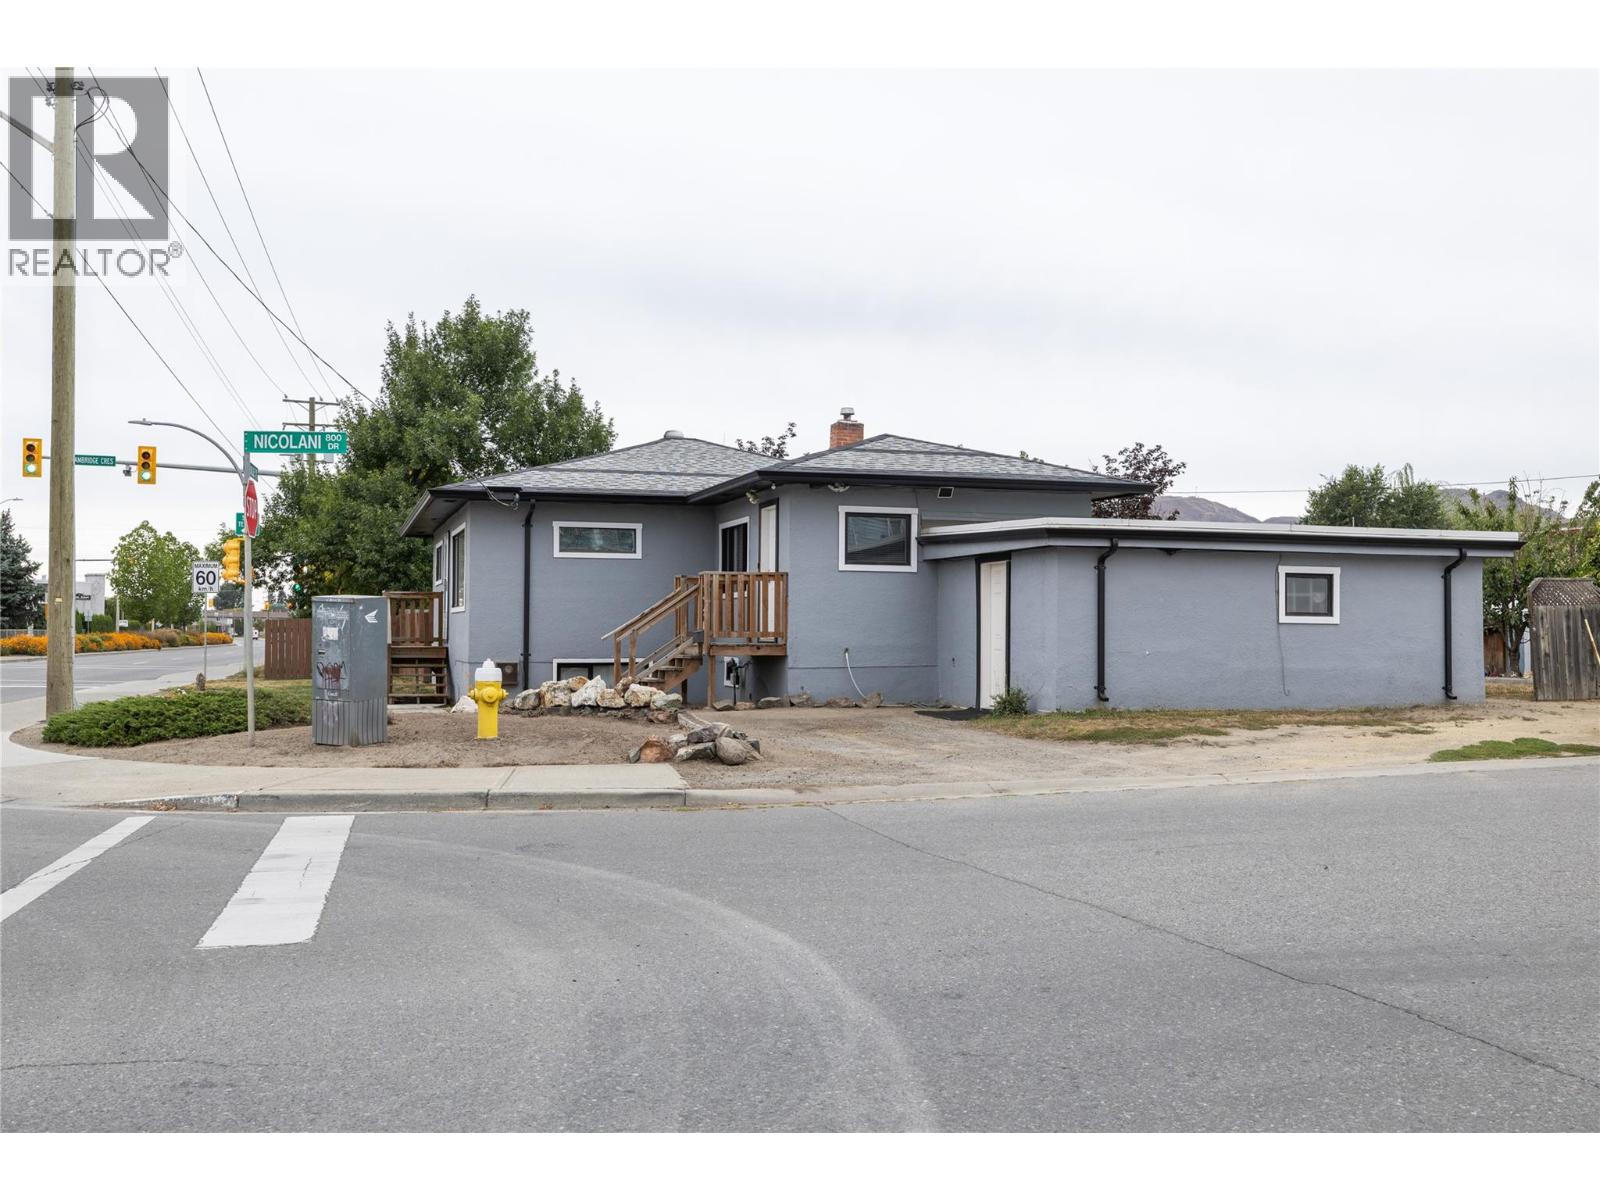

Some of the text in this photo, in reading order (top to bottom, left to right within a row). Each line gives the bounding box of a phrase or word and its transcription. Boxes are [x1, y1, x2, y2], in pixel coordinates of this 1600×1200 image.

[253, 434, 322, 450] NICOLANI
[325, 434, 342, 442] 800
[247, 496, 258, 519] STOP
[196, 570, 216, 586] 60
